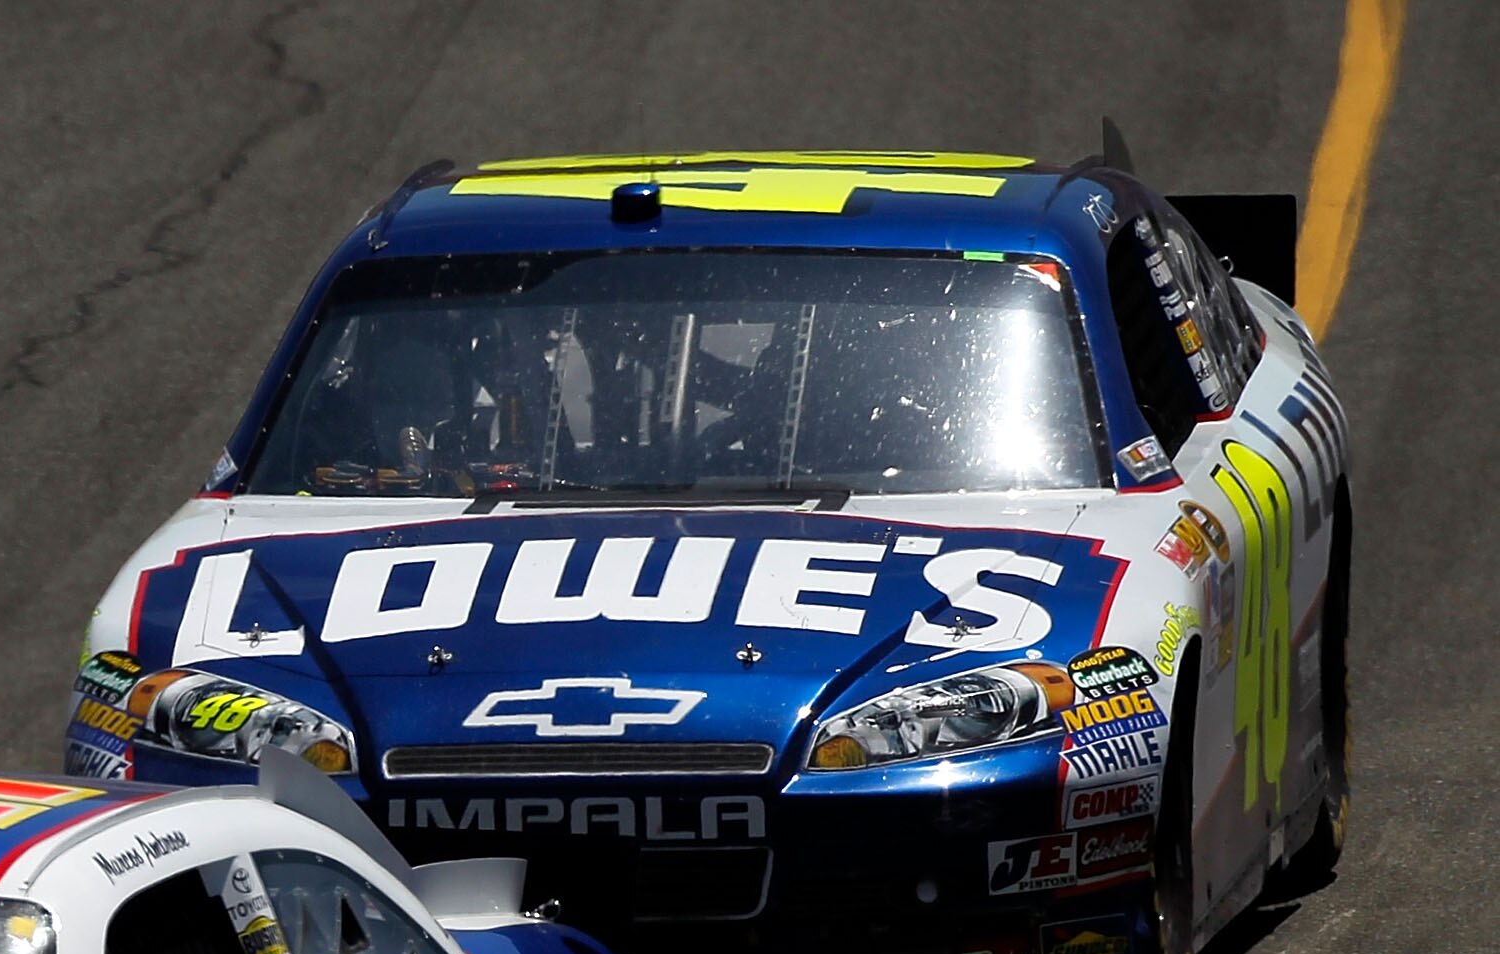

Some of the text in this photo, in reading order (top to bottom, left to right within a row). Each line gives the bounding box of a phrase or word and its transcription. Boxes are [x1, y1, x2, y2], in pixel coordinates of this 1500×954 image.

[173, 536, 1062, 661] LOWE'S
[1213, 439, 1291, 812] 48
[1070, 649, 1127, 671] GOODYEAR
[1073, 659, 1148, 690] Gatorback
[1088, 675, 1154, 700] BELTS
[76, 698, 144, 740] MOOG
[188, 693, 270, 732] 48
[1060, 689, 1157, 734] MOOG
[1075, 713, 1163, 745] CHASSIS PARTS
[1063, 731, 1162, 780] MAHLE
[387, 796, 766, 840] IMPALA
[1072, 784, 1140, 820] COMP
[990, 835, 1073, 892] JE
[1080, 830, 1150, 866] Edelbrock
[92, 852, 145, 885] Marcos
[1018, 877, 1077, 892] PISTONS
